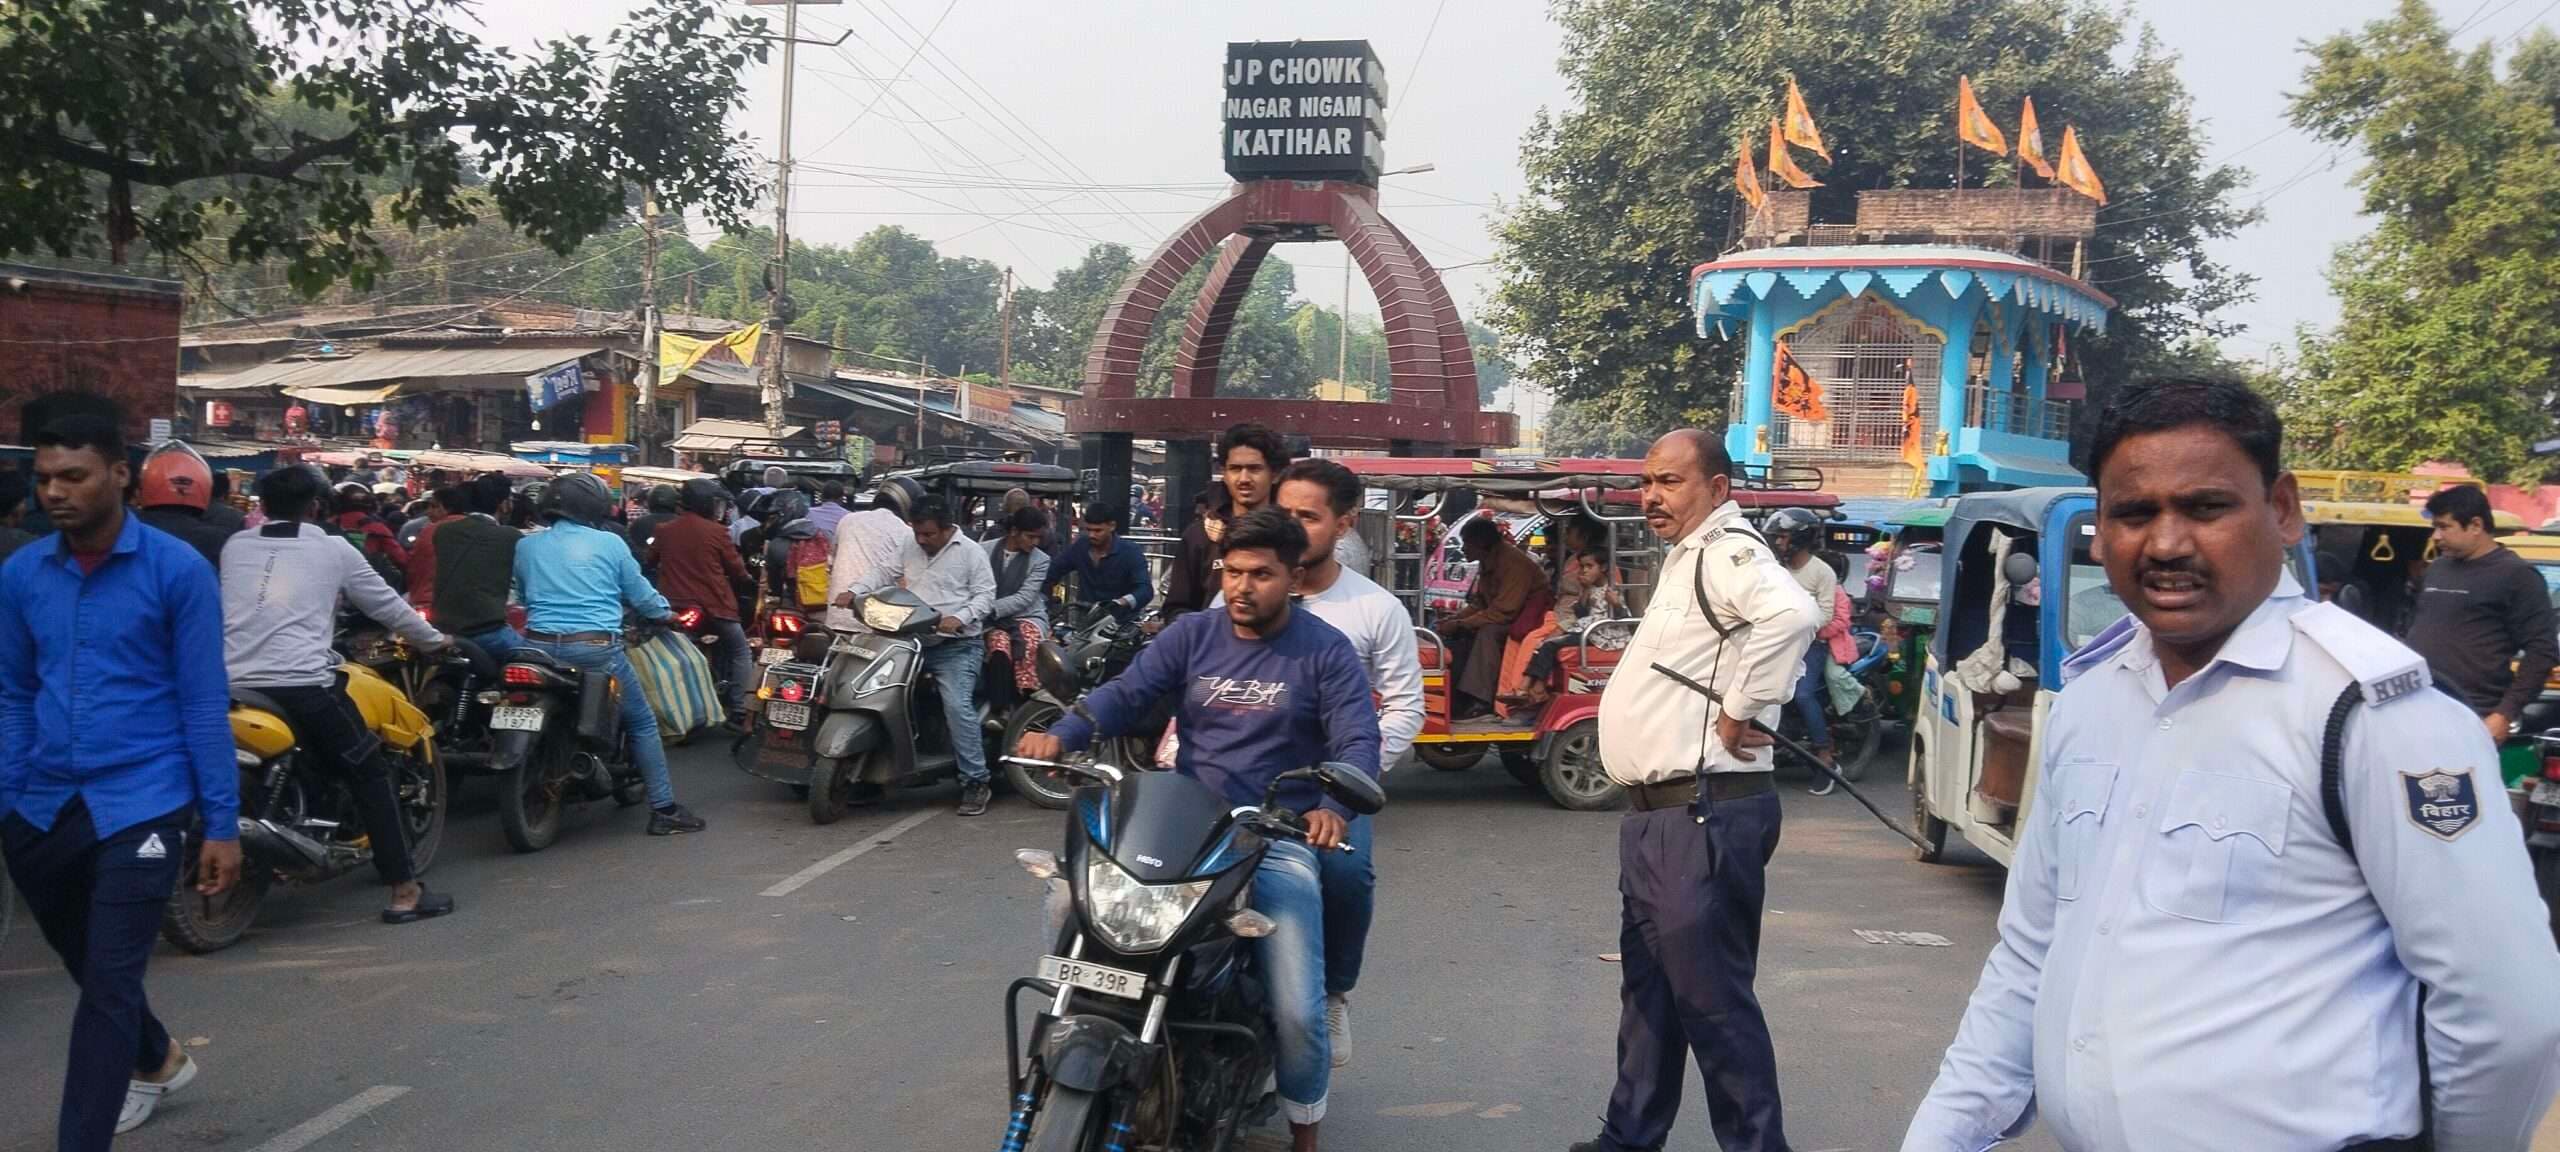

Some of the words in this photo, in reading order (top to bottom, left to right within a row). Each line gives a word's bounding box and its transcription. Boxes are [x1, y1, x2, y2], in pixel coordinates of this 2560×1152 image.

[1269, 56, 1364, 86] CHOWK
[1227, 97, 1292, 119] NAGAR
[1299, 95, 1362, 119] NIGAM
[1232, 127, 1352, 157] KATIHAR
[2419, 803, 2474, 818] बिहार
[1058, 963, 1082, 983] BR
[1094, 971, 1129, 993] 39R
